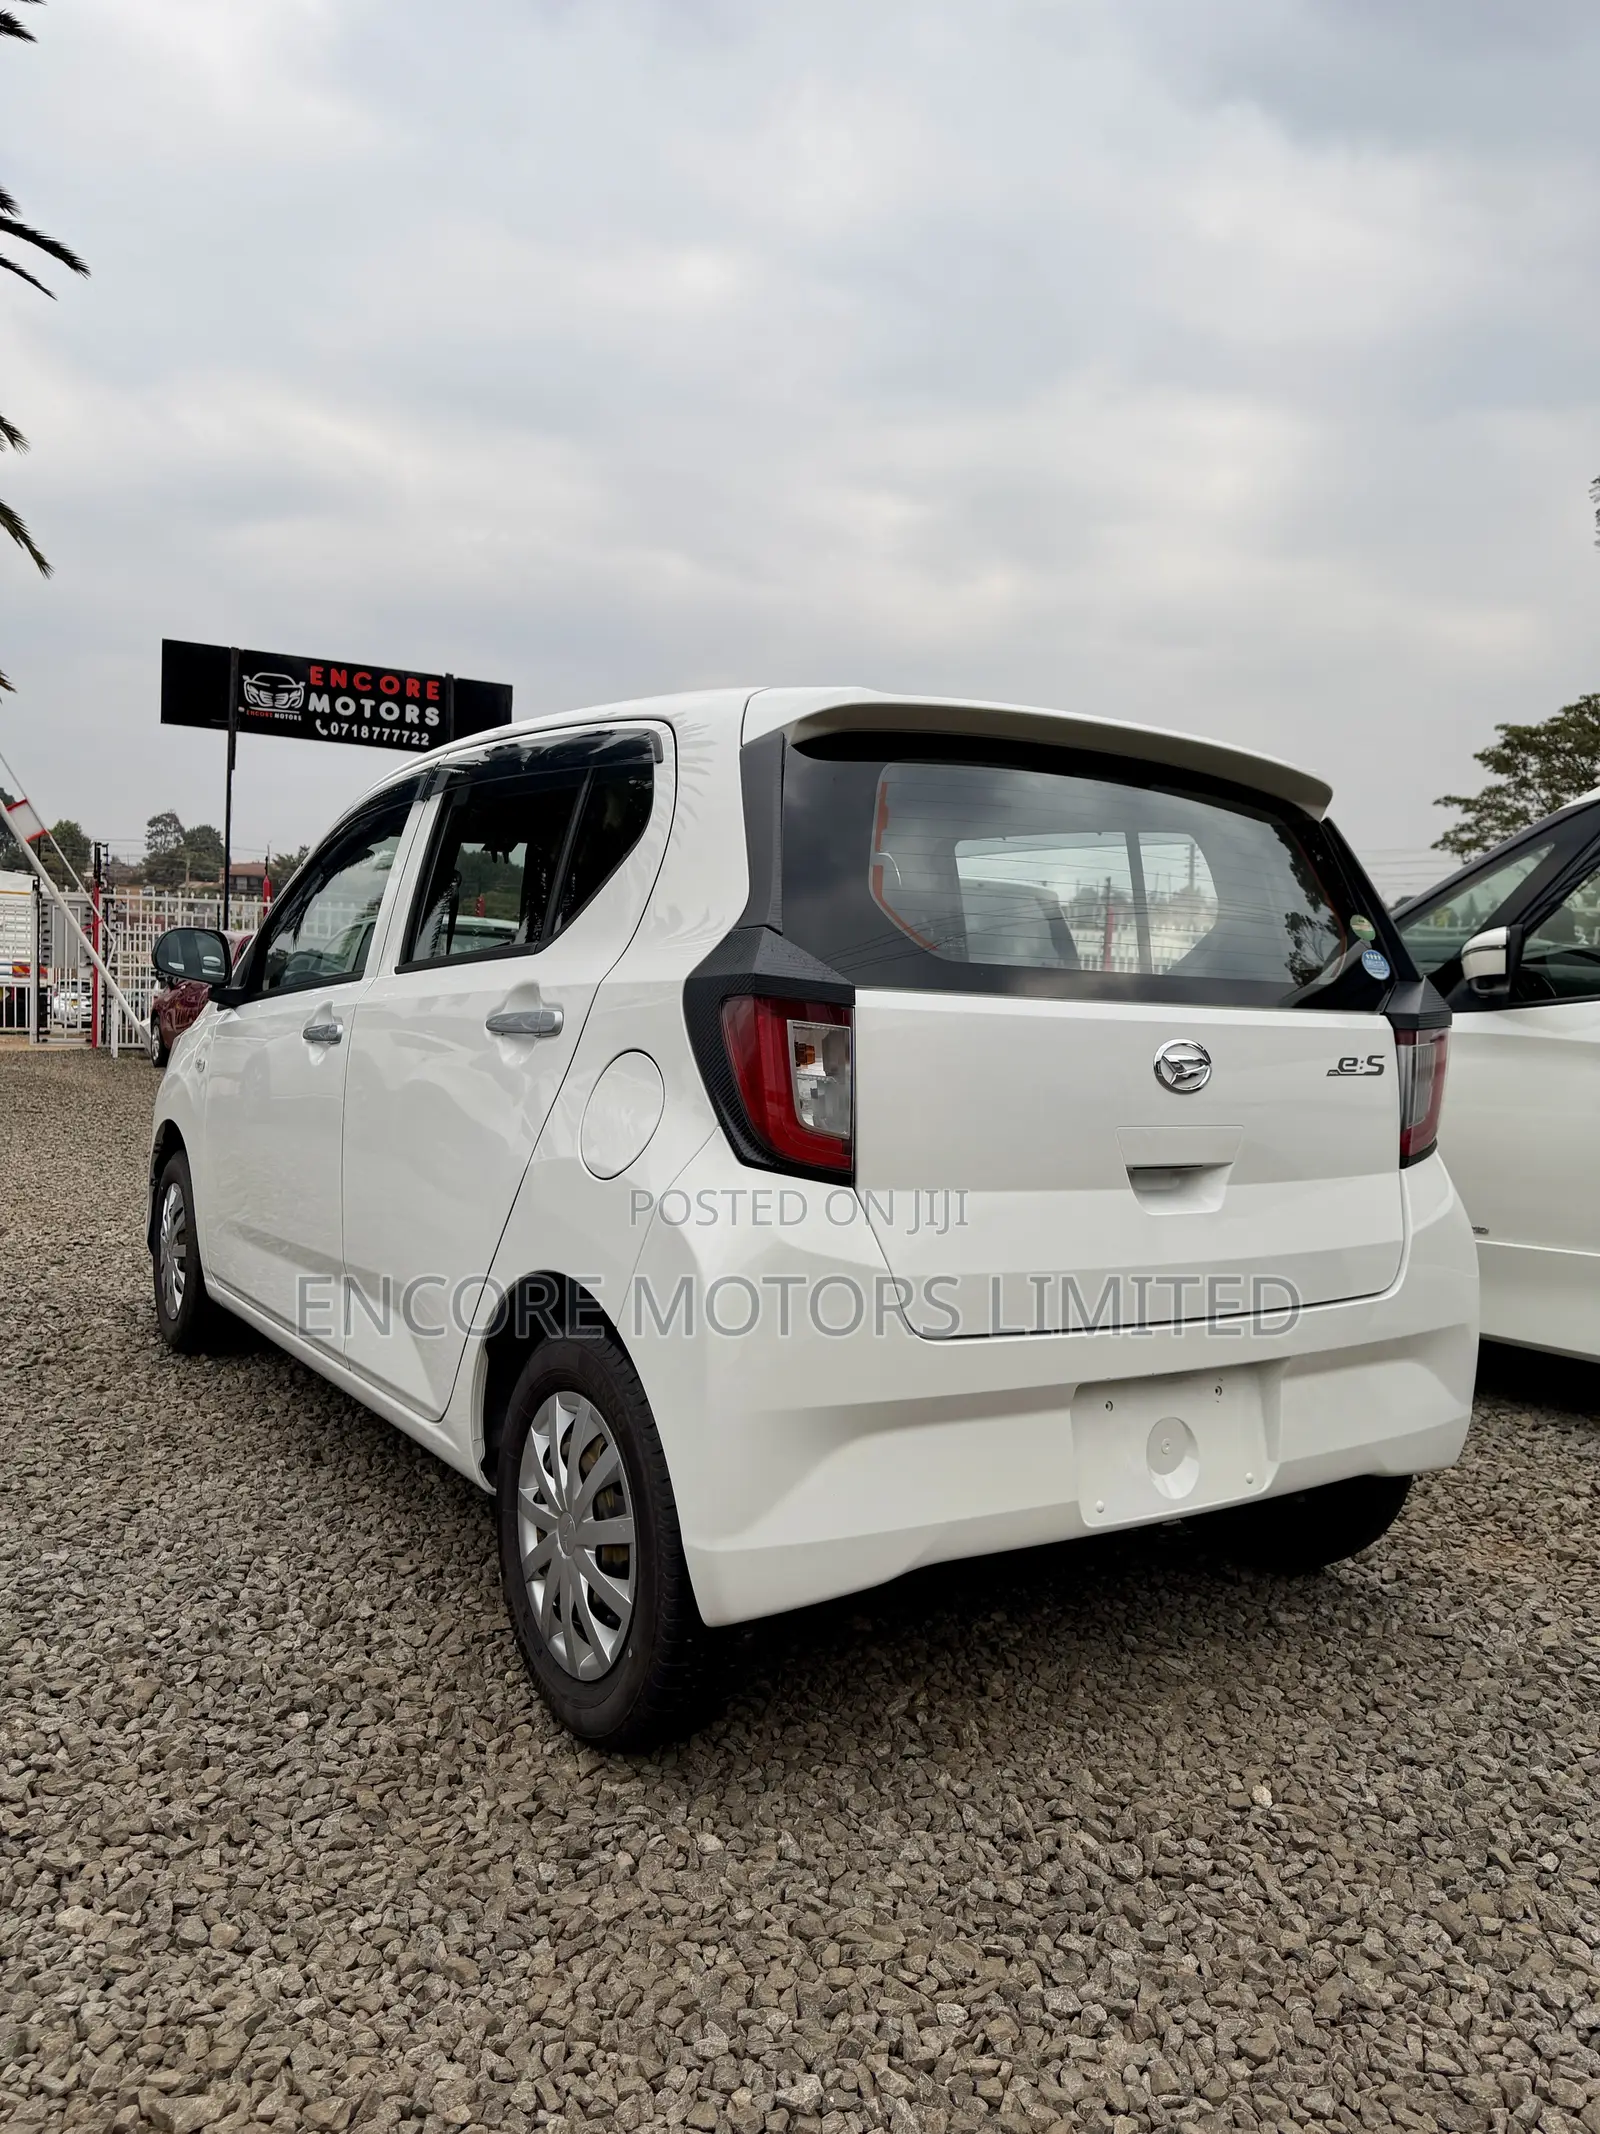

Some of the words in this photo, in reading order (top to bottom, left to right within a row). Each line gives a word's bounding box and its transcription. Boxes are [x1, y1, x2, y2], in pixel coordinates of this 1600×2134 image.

[309, 665, 440, 700] ENCORE
[274, 712, 302, 721] MOTORS
[308, 692, 440, 727] MOTORS
[330, 722, 430, 745] 0718777722
